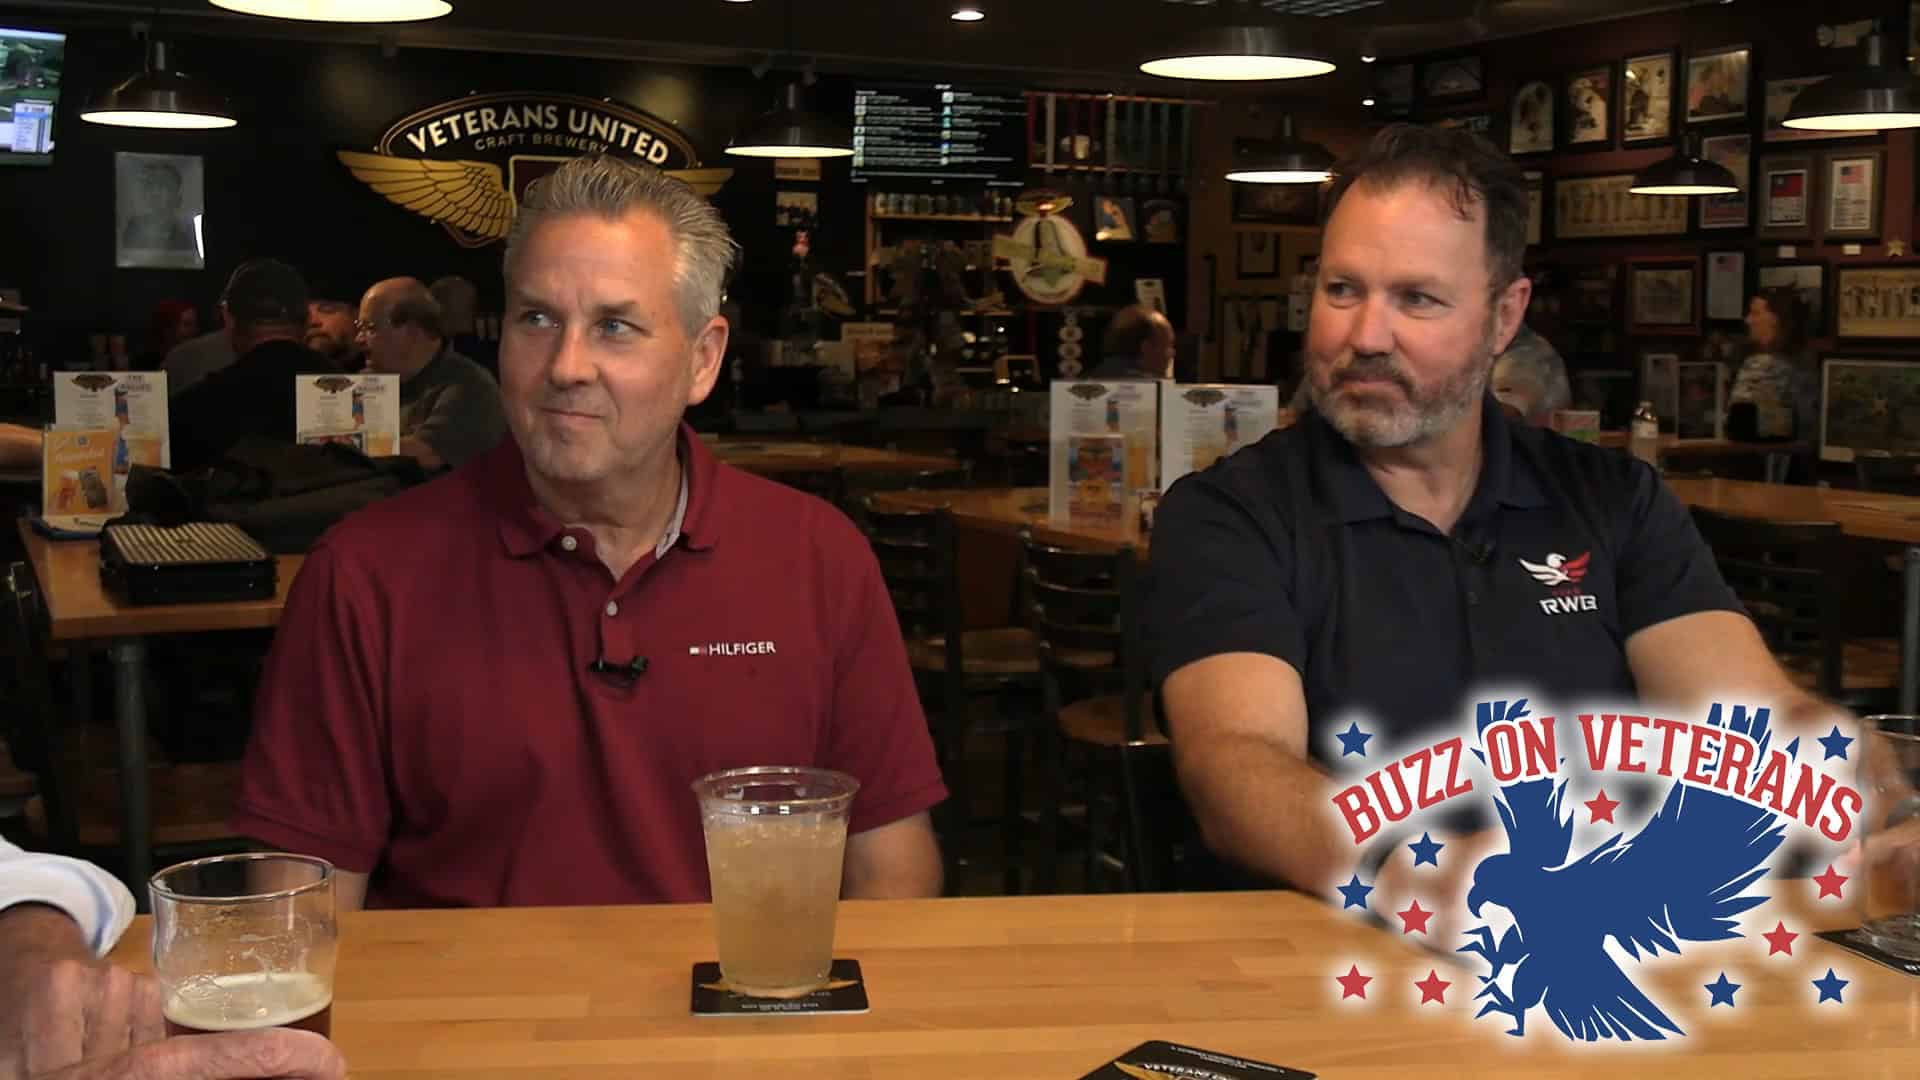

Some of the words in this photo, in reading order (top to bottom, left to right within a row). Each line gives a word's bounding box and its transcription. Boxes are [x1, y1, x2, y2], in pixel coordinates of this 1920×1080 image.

[406, 104, 558, 153] VETERANS
[568, 109, 669, 164] UNITED
[474, 133, 525, 151] CRAFT
[532, 133, 609, 153] BREWERY
[709, 641, 776, 655] HILFIGER
